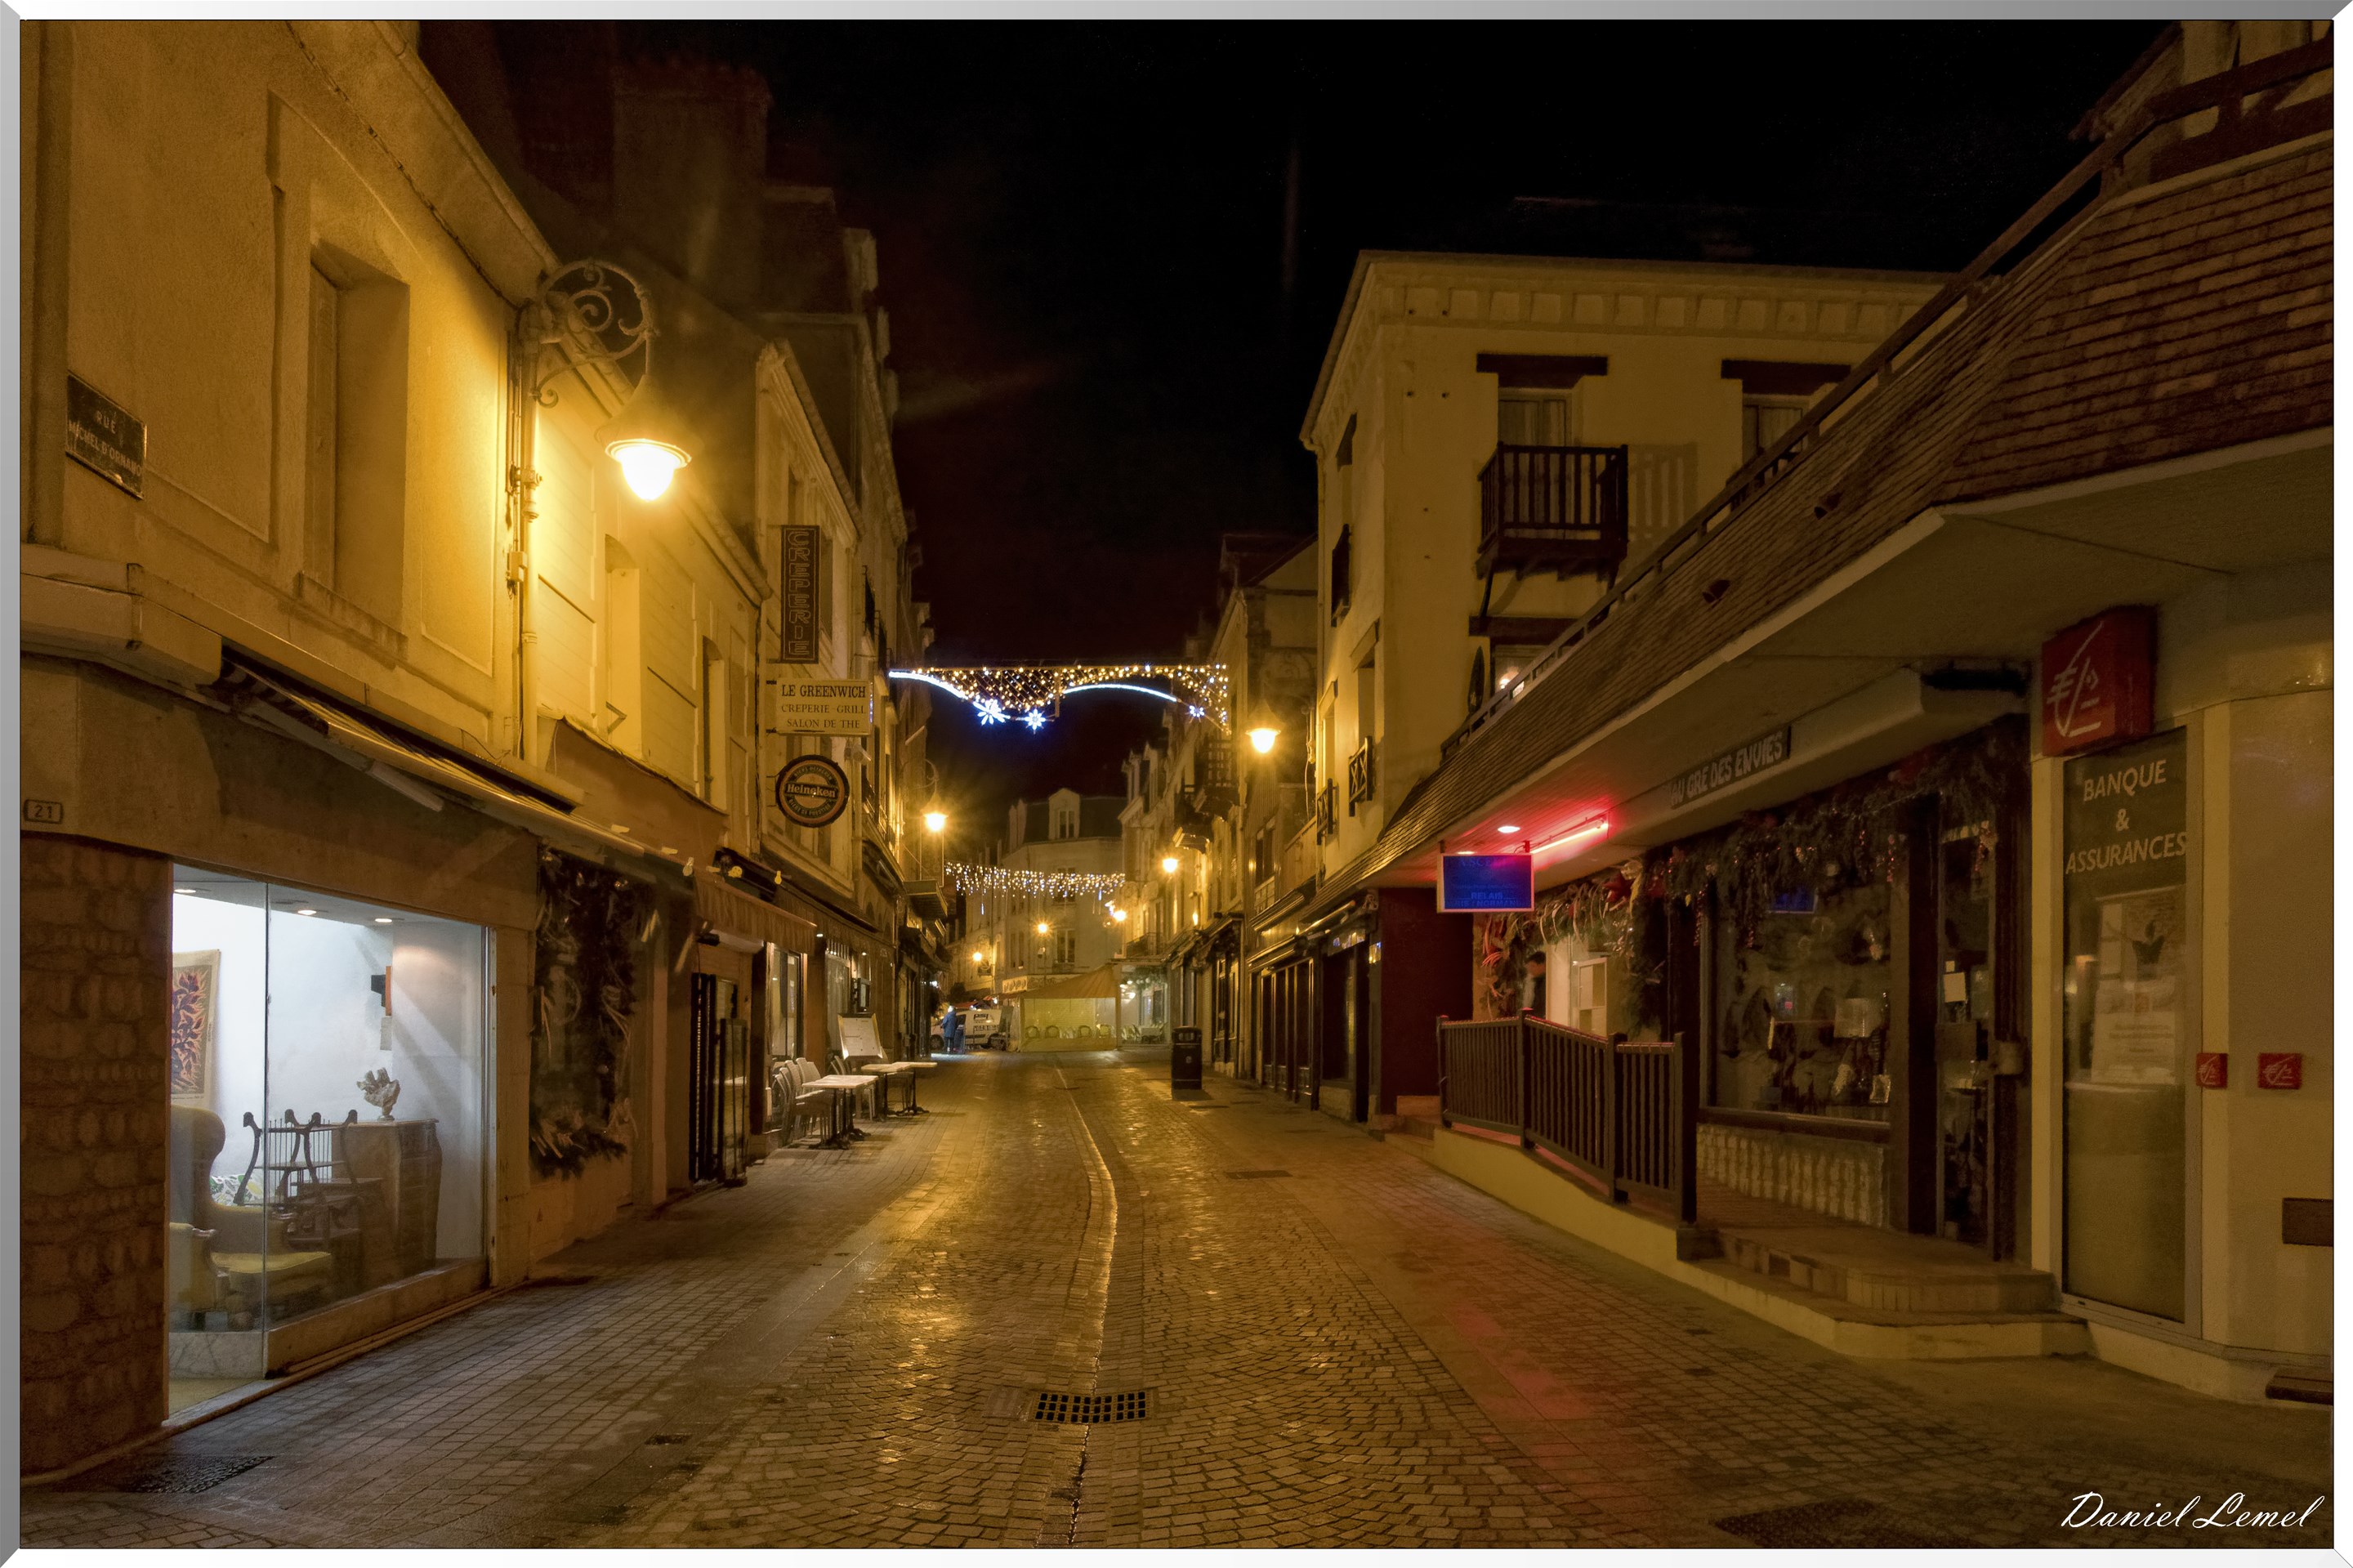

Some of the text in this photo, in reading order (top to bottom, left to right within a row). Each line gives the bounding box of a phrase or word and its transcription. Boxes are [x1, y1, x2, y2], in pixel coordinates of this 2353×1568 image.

[96, 410, 116, 434] RUE
[788, 531, 810, 655] CREPERIE
[782, 685, 865, 698] LE GREENWICH
[837, 704, 867, 714] GRILL
[787, 719, 859, 729] SALON DE THE
[1710, 754, 1732, 788] DES
[1735, 730, 1783, 777] ENVIES
[787, 783, 836, 797] Heineken
[2083, 759, 2167, 802] BANQUE
[34, 804, 52, 819] 21
[2115, 808, 2130, 832] &
[2065, 831, 2187, 874] ASSURANCES
